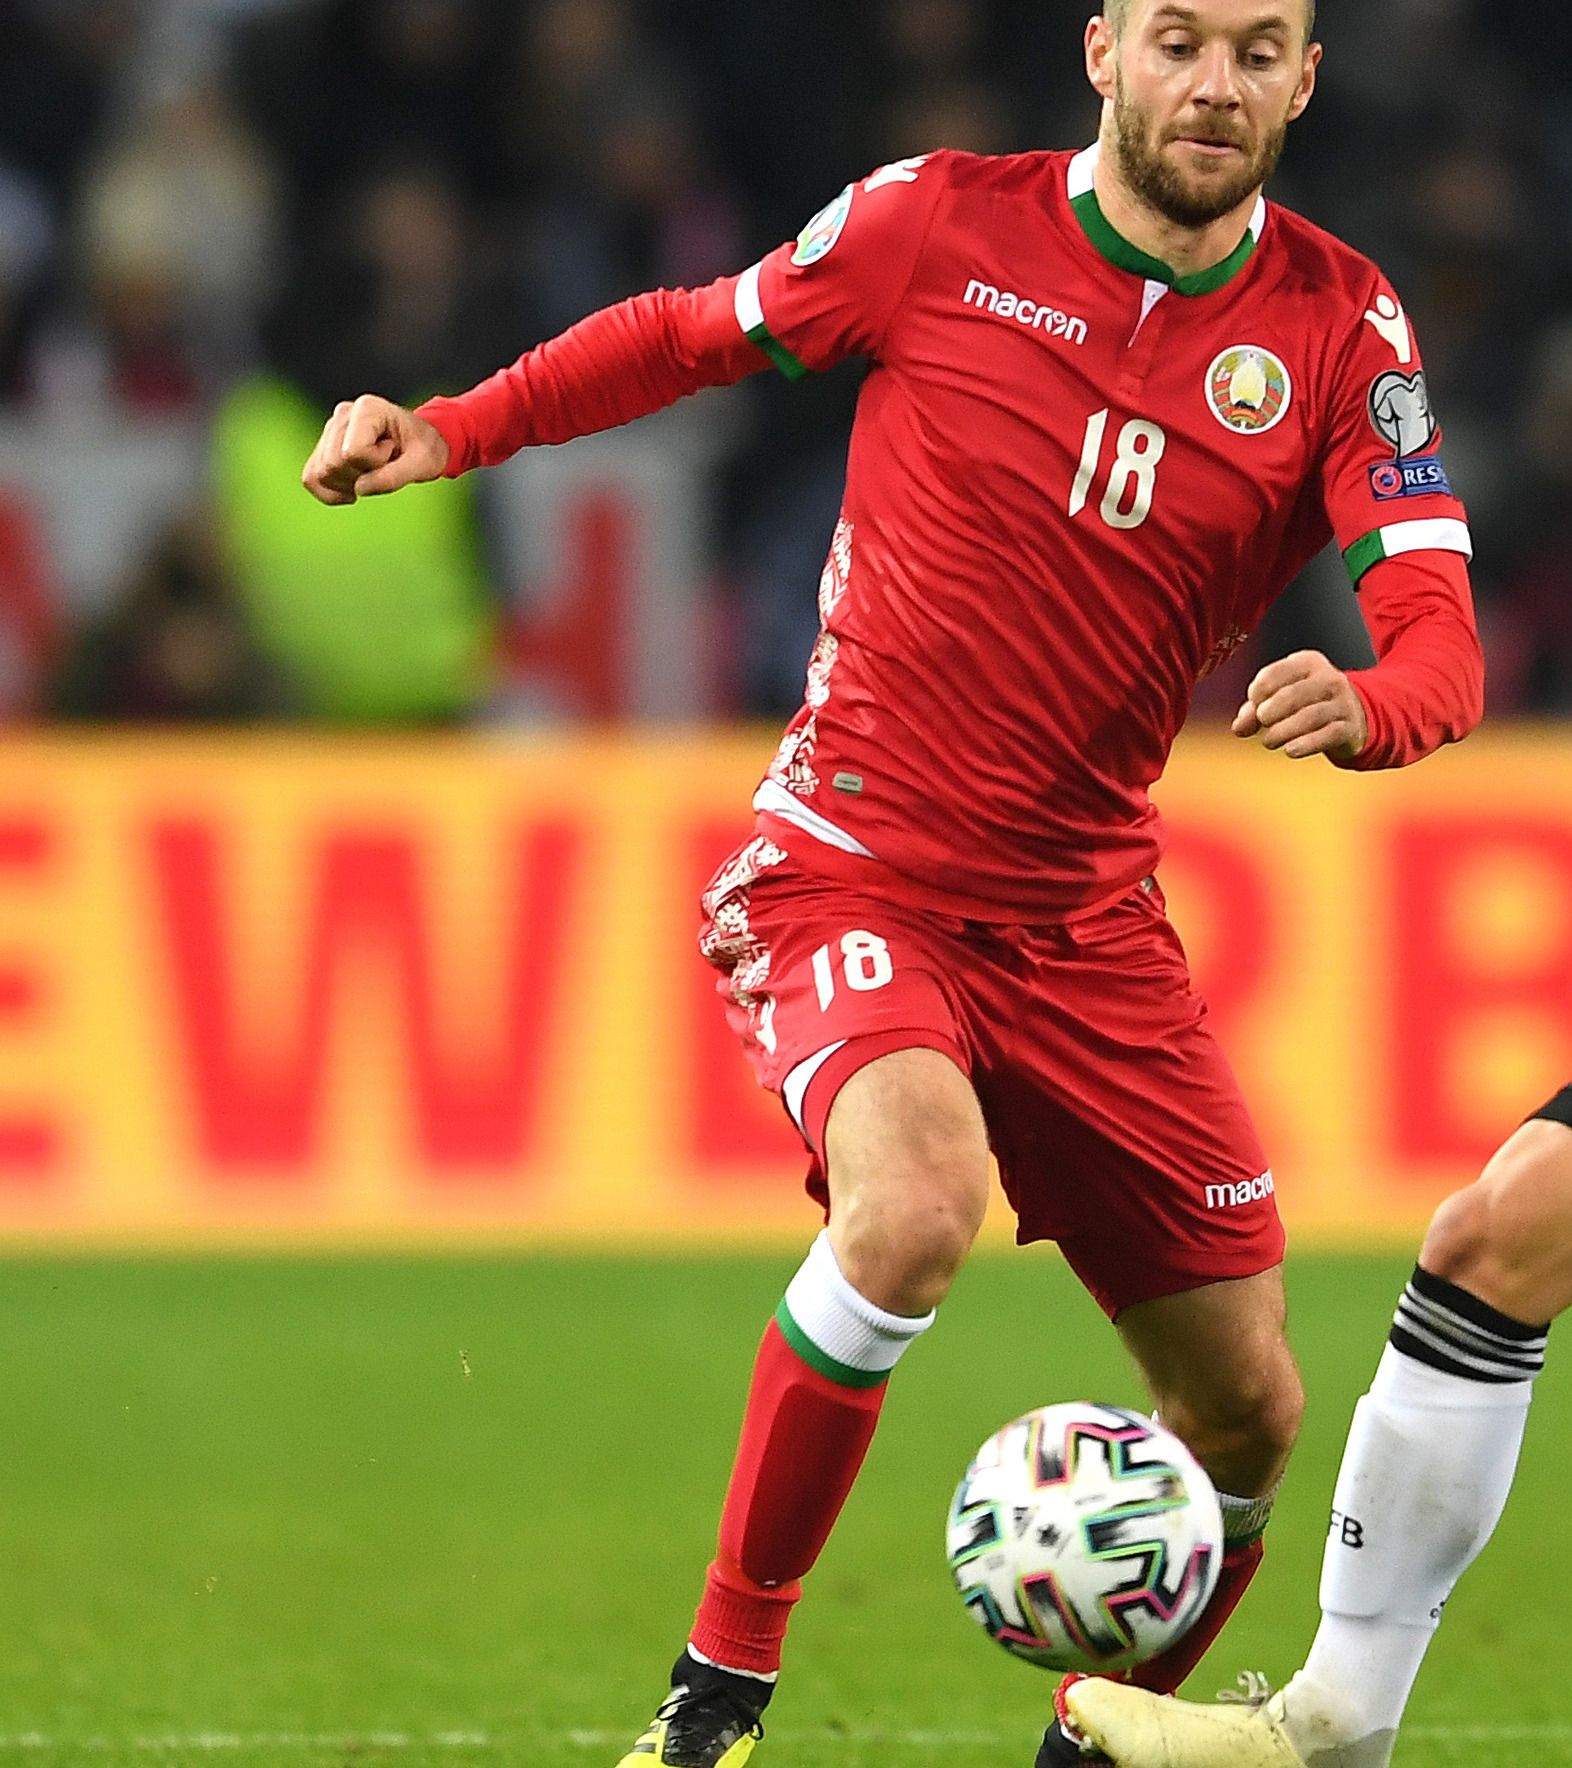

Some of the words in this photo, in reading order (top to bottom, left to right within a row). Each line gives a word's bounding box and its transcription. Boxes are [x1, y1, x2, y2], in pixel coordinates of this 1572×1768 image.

[963, 279, 1088, 345] macron
[1068, 407, 1166, 529] 18
[811, 929, 893, 1013] 18
